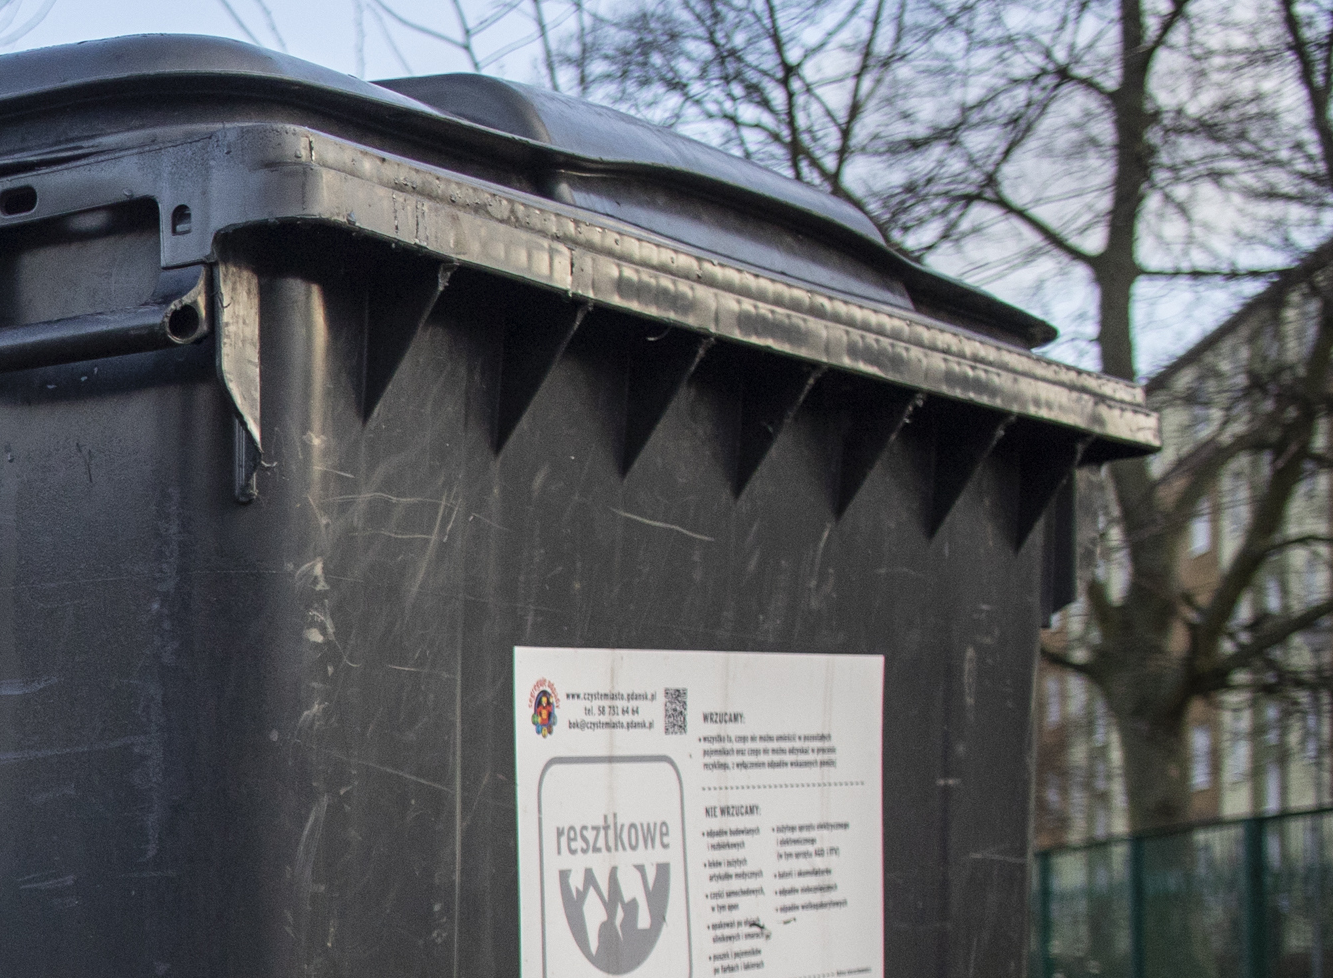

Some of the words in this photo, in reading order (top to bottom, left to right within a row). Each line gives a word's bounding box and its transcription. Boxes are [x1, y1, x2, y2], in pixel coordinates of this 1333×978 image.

[565, 691, 657, 702] www.czystemiasto.gdansk.pl
[584, 705, 595, 716] tel.
[597, 705, 605, 716] 58
[608, 705, 619, 716] 731
[621, 705, 629, 715] 64
[631, 705, 639, 715] 64
[703, 712, 745, 724] WRZUCAMY:
[568, 720, 655, 732] bok@czystemiasto.gdansk.pl
[705, 806, 718, 818] NIE
[719, 804, 761, 817] WRZUCAMY:
[555, 812, 670, 856] resztkowe
